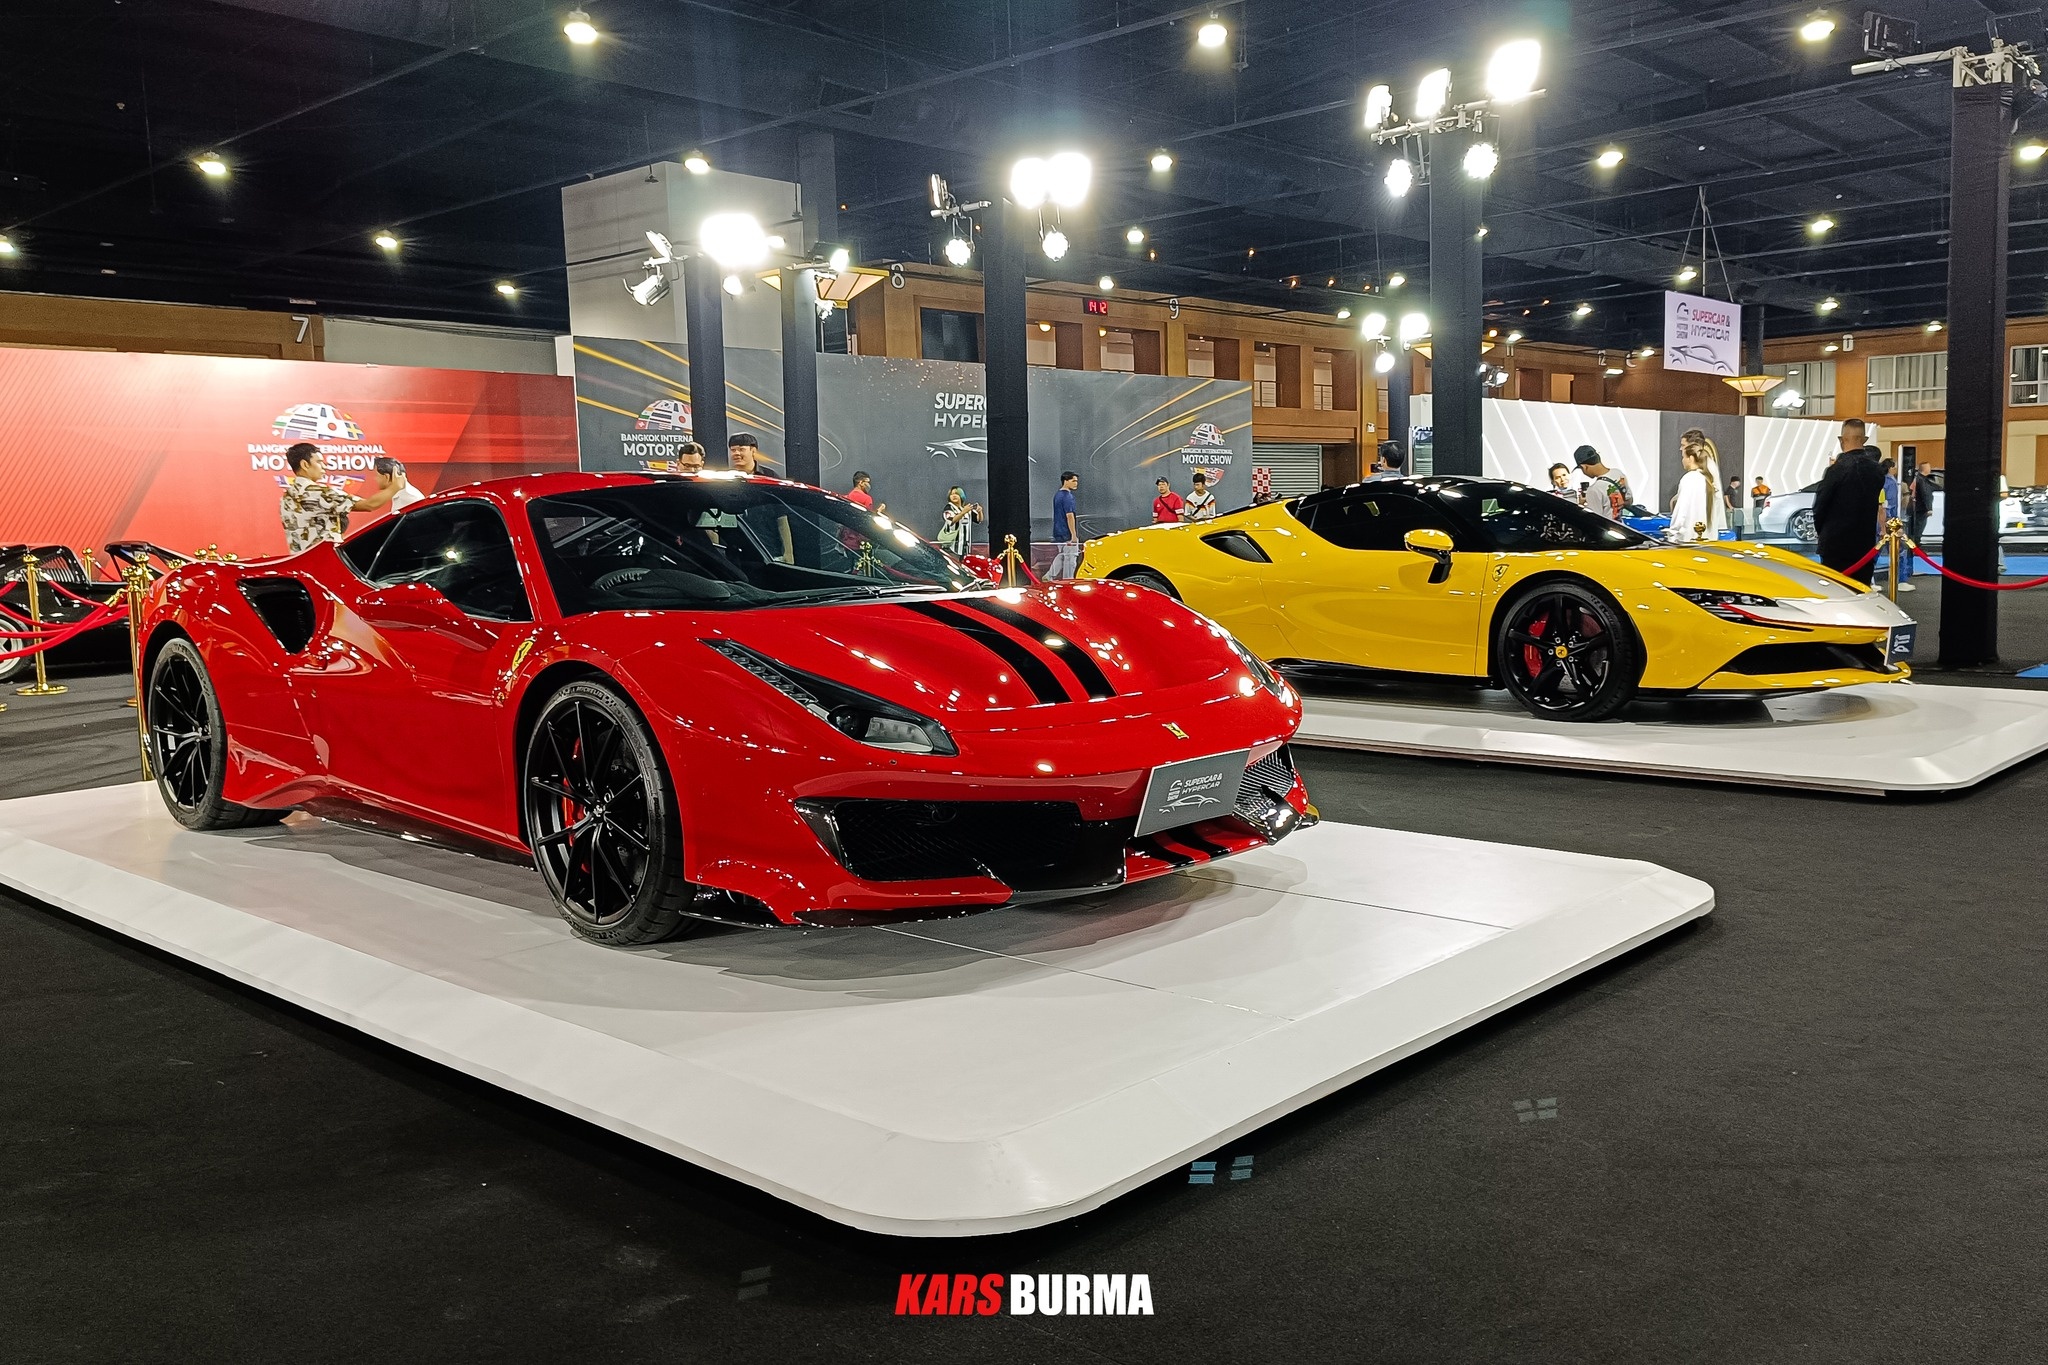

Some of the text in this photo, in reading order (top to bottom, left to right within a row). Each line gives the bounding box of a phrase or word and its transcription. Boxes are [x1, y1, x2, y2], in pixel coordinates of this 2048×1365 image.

[890, 262, 906, 289] 8
[1169, 298, 1180, 320] 9
[1692, 309, 1731, 328] SUPERCAR &
[292, 315, 309, 343] 7
[1691, 324, 1730, 342] HYPERCAR
[934, 392, 987, 411] SUPER
[934, 412, 987, 429] HYPE
[620, 433, 694, 443] BANGKOK INTERNA
[623, 442, 675, 457] MOTOR
[1182, 454, 1232, 465] MOTOR SHOW
[1181, 781, 1221, 795] HYPERCAR
[1184, 773, 1218, 788] SUPERCAR
